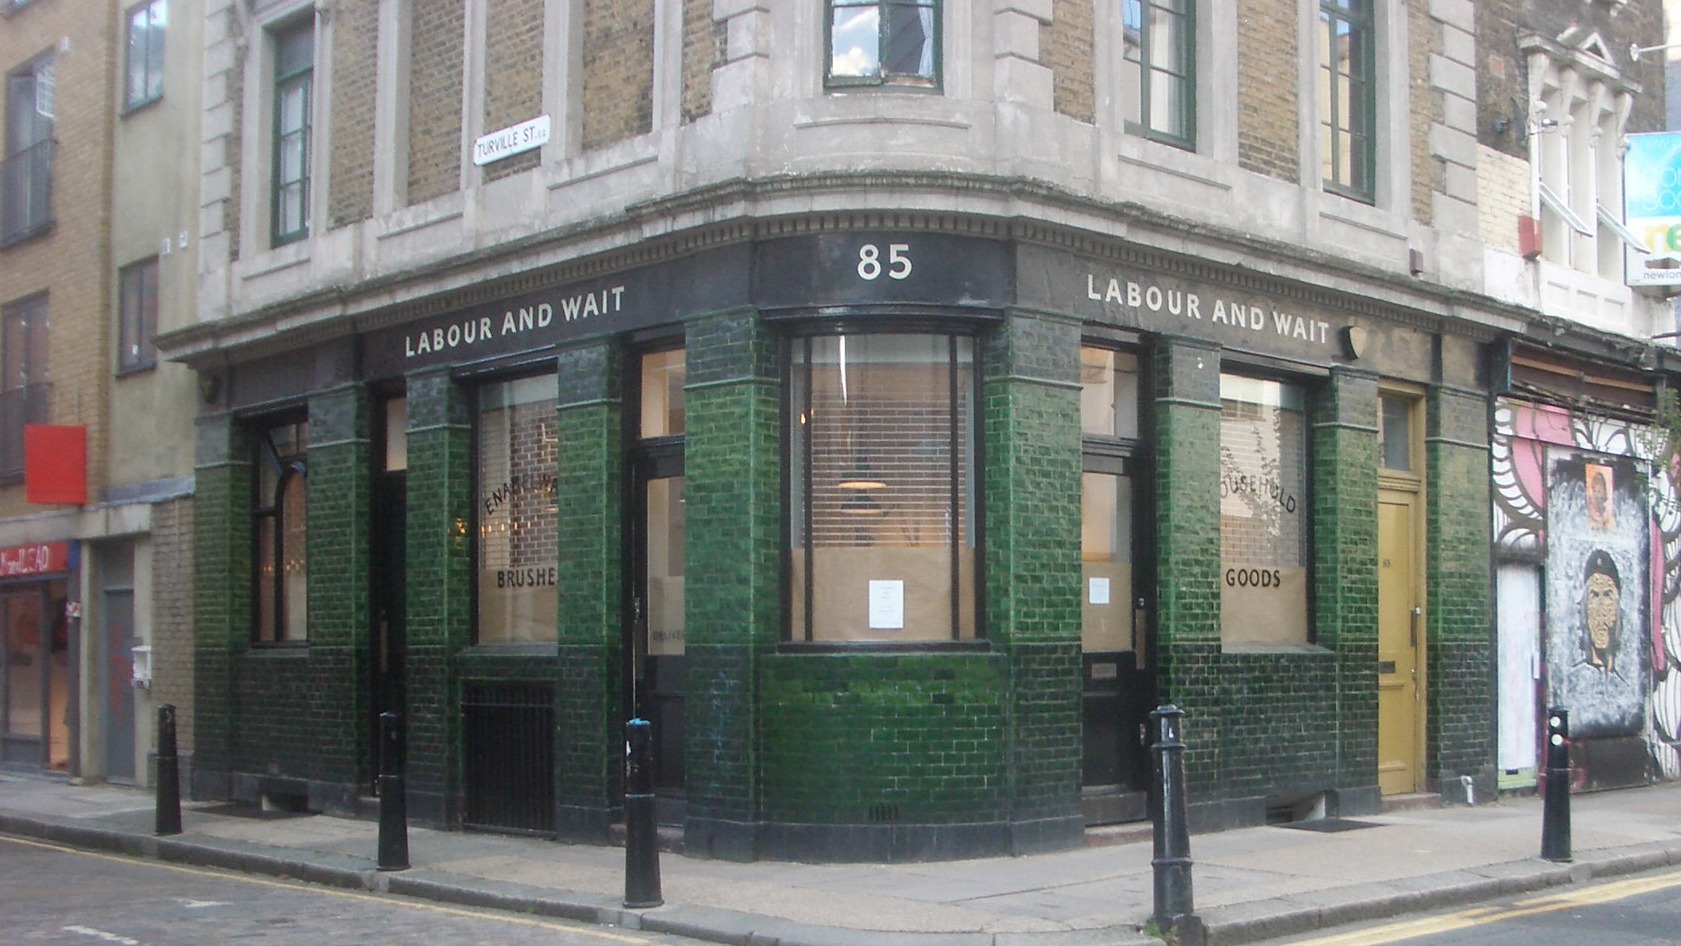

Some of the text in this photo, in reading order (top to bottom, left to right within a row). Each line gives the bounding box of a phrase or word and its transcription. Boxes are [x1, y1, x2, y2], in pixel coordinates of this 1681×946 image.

[477, 131, 518, 157] TURVILLE
[857, 244, 912, 280] 85
[405, 286, 624, 357] LABOUR AND WAIT
[1087, 274, 1329, 343] LABOUR AND WAIT
[497, 567, 556, 588] BRUSHE
[1226, 568, 1281, 588] GOODS
